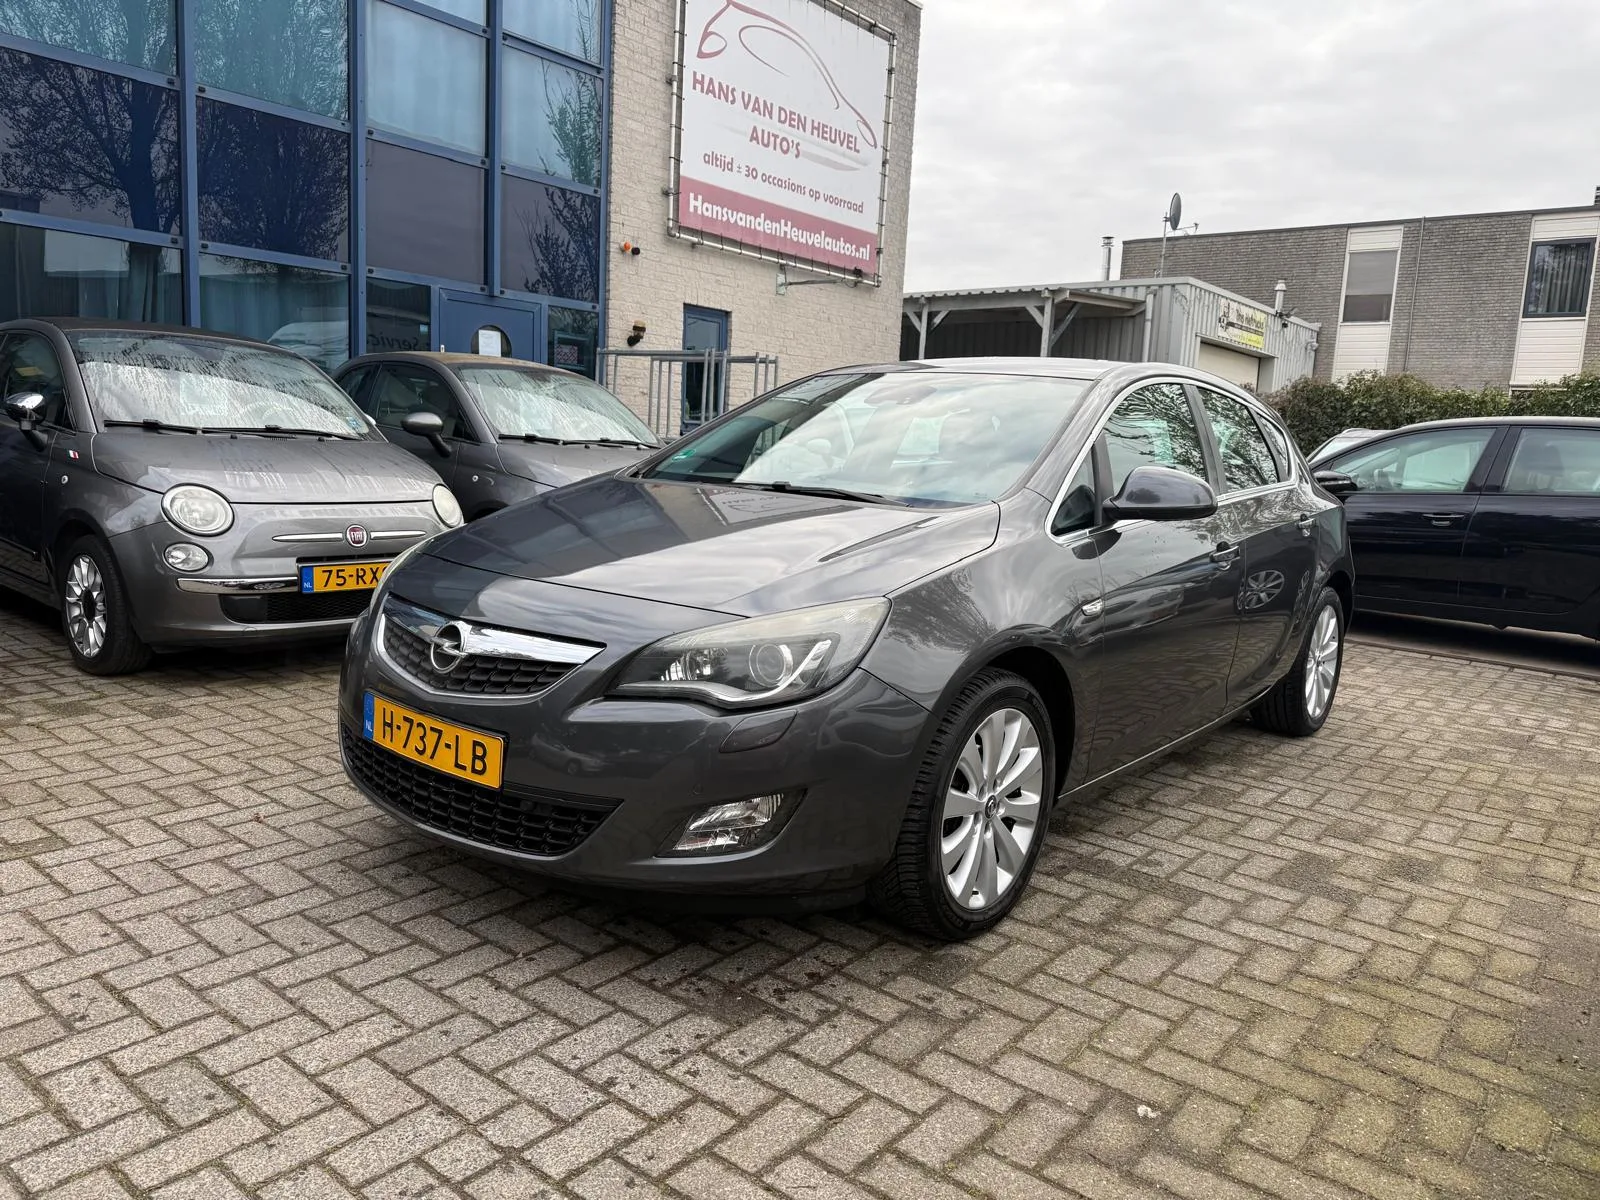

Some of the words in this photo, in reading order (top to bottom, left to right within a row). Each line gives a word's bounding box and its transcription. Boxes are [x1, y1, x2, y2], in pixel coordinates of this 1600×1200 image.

[692, 70, 736, 105] HANS
[741, 91, 774, 120] VAN
[777, 105, 807, 133] DEN
[810, 119, 860, 153] HEUVEL
[749, 125, 801, 159] AUTO'S
[703, 151, 734, 172] altijd
[745, 165, 758, 180] 30
[761, 172, 806, 196] occasions
[808, 188, 821, 202] op
[823, 193, 864, 213] voorraad
[689, 192, 870, 261] HansvandenHeuvelautos.nl
[321, 566, 387, 588] 75-RX
[365, 719, 373, 732] NL
[382, 707, 488, 776] H-737-LB
